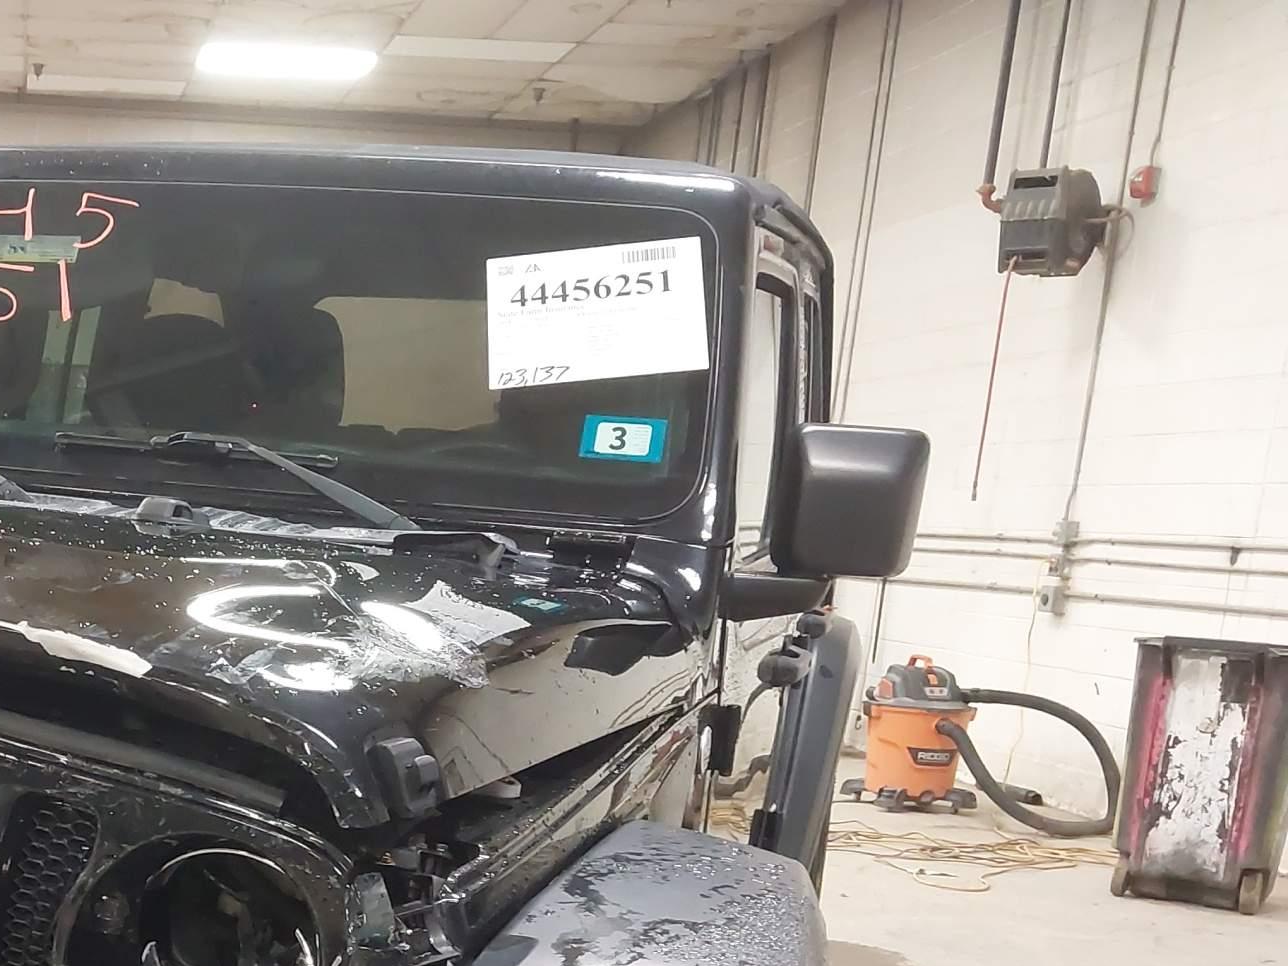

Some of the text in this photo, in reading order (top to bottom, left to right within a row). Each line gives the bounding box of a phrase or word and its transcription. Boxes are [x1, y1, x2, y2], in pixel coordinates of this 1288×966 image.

[510, 269, 673, 307] 44456251
[498, 365, 571, 387] 123,137
[608, 426, 628, 451] 3
